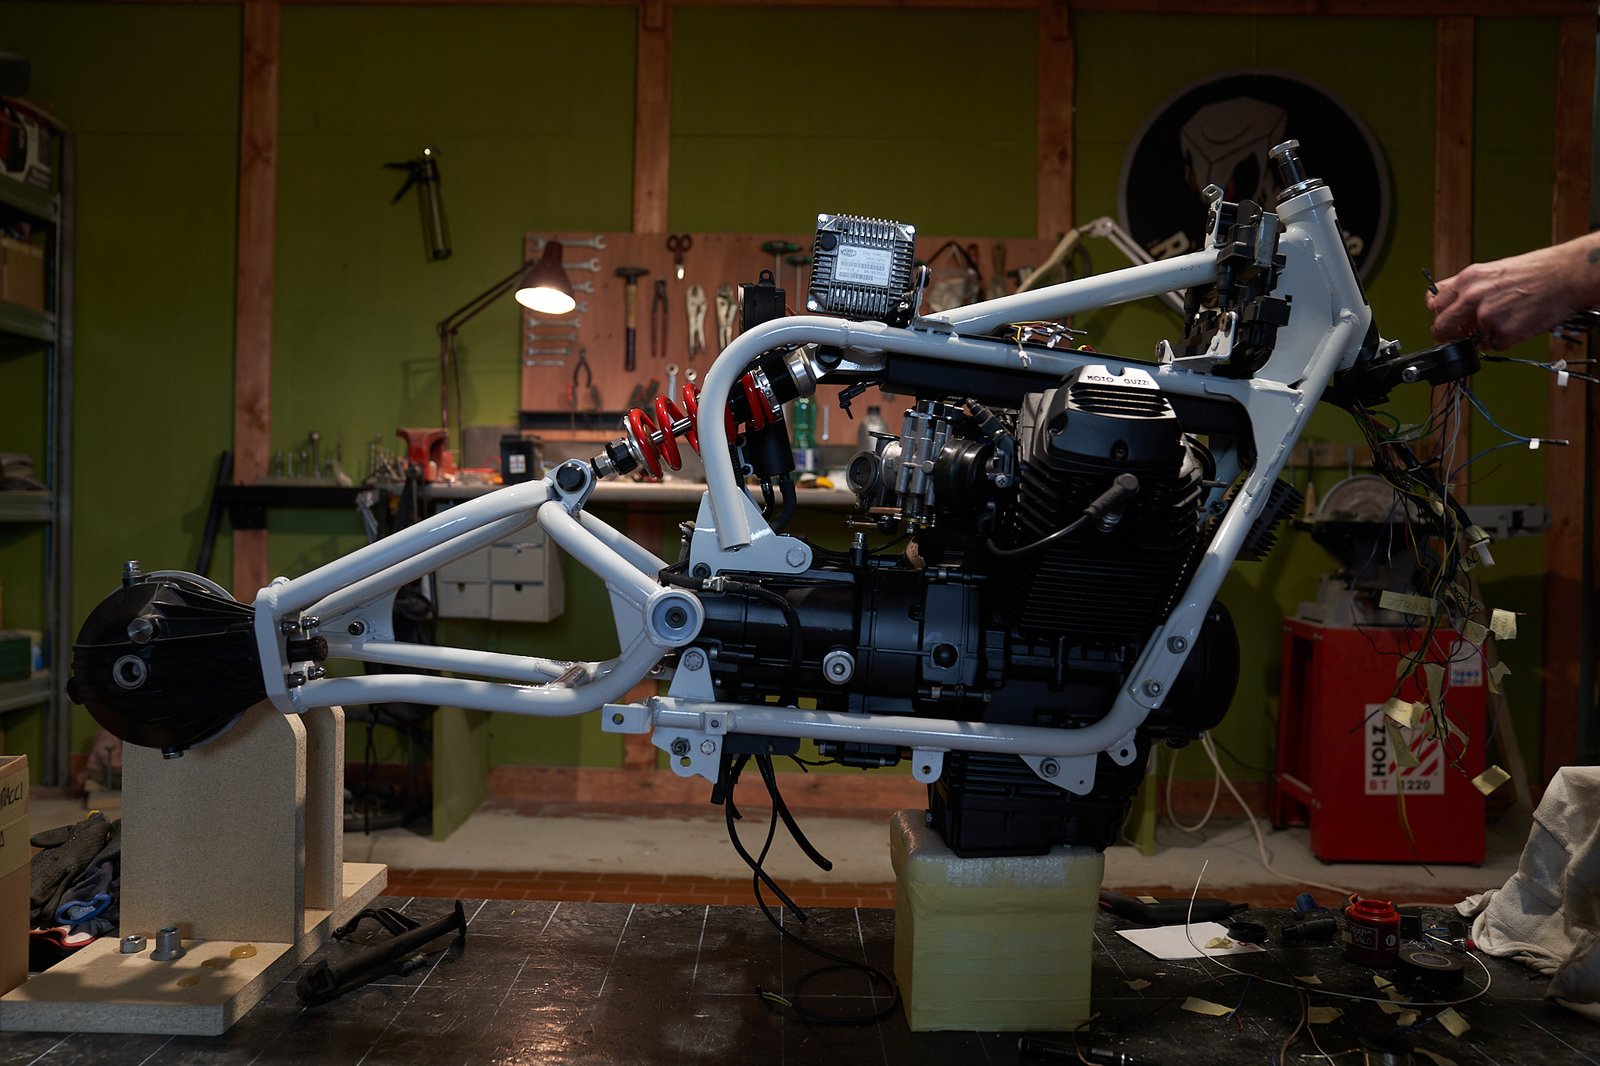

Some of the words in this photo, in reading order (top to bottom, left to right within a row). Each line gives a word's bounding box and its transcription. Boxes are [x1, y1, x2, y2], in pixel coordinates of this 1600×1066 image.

[1087, 375, 1114, 383] MOTO
[1123, 378, 1149, 386] GUZZI
[1373, 726, 1386, 776] HOLZ
